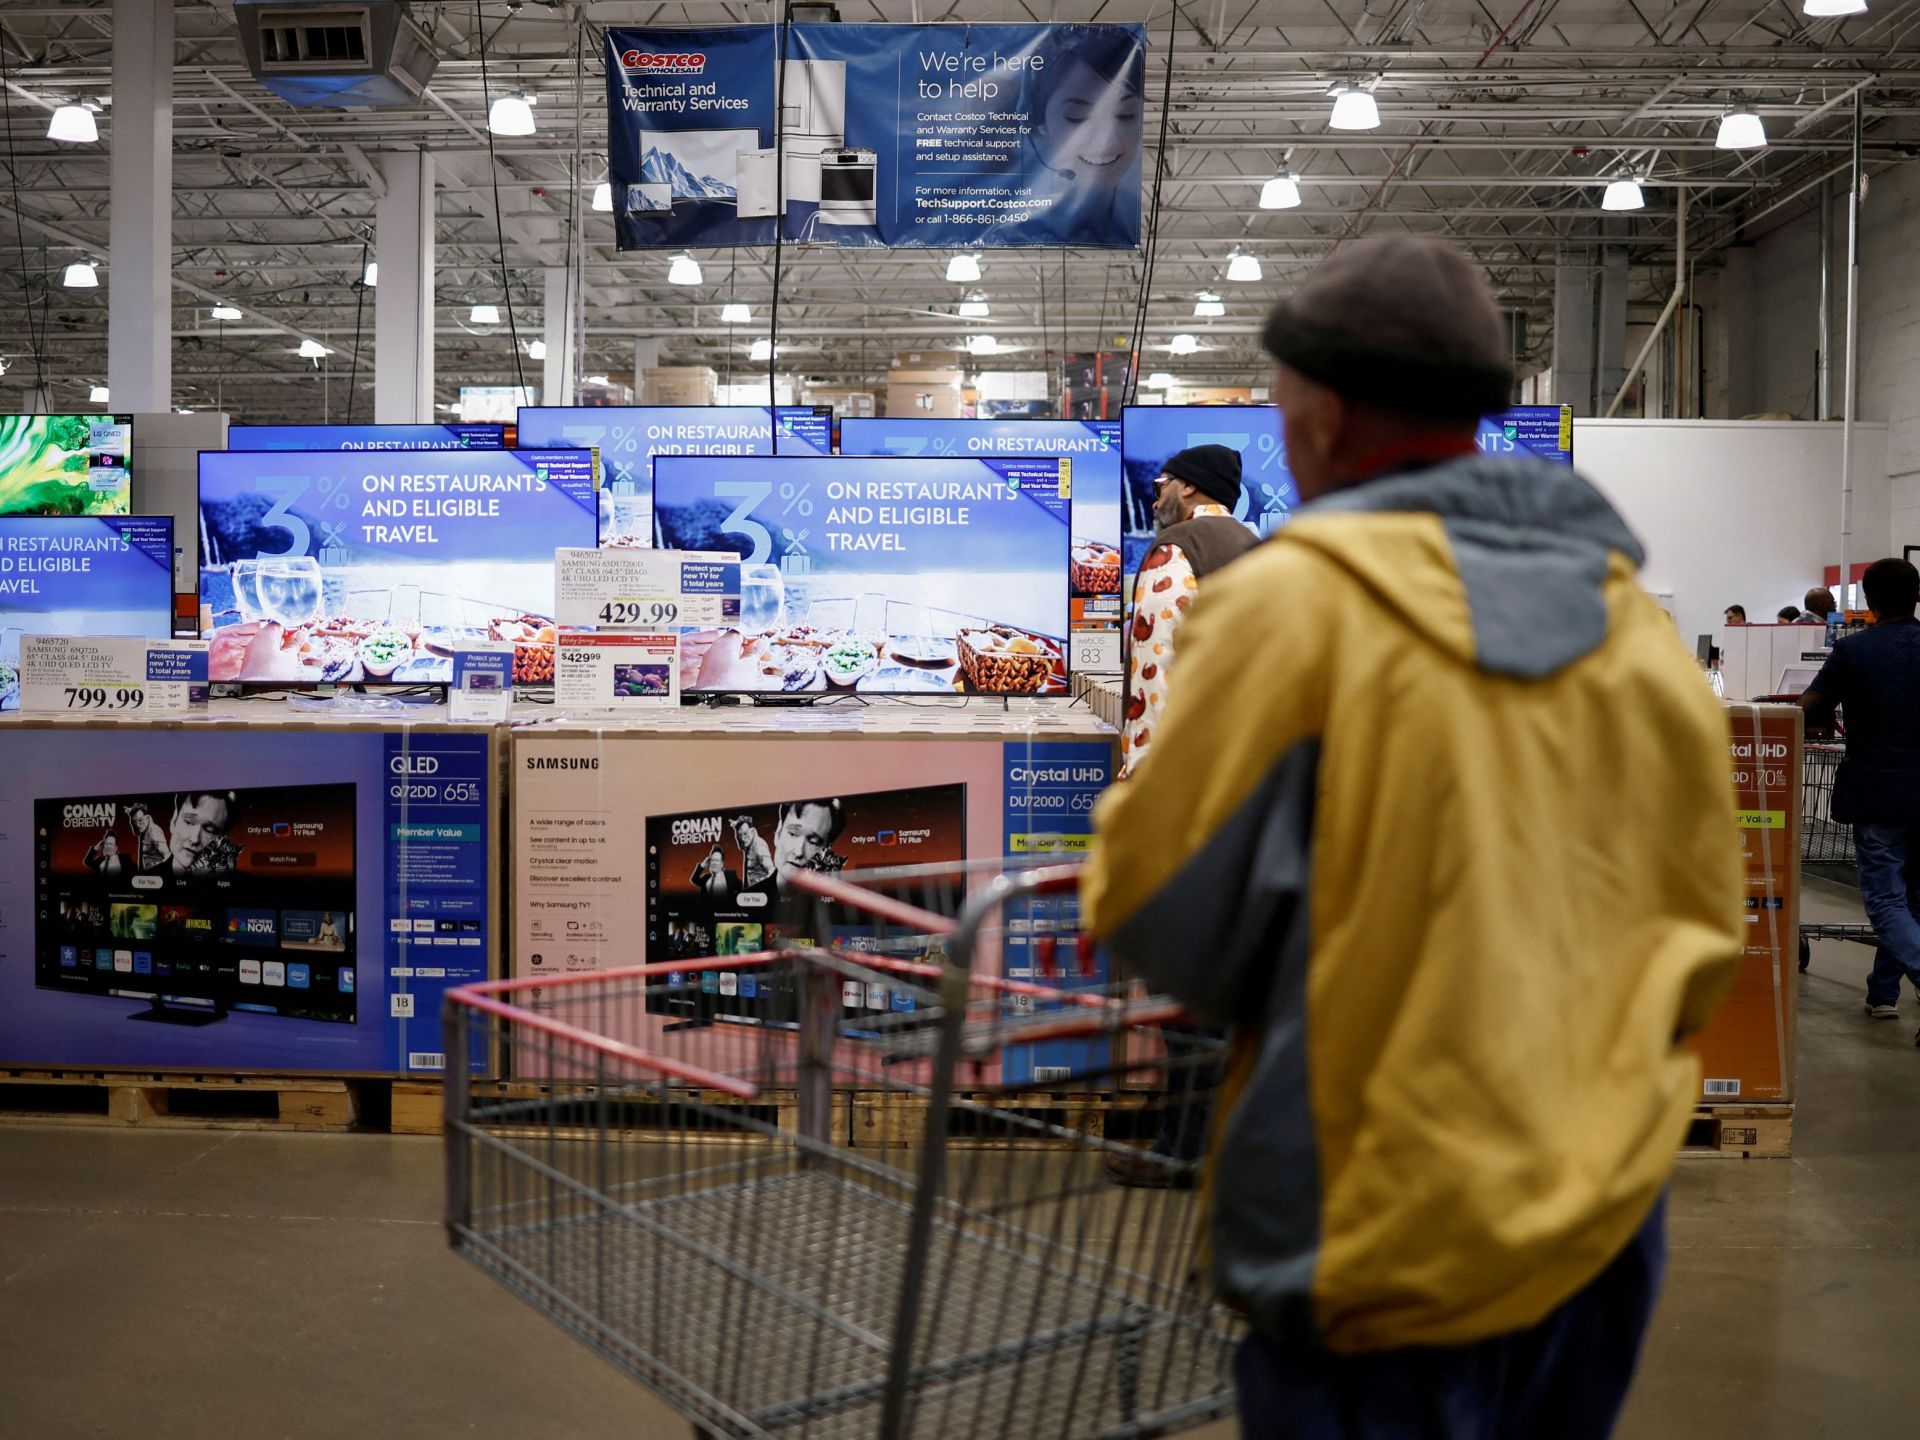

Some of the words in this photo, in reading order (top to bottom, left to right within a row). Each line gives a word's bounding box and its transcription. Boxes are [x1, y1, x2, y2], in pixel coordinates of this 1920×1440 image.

[622, 50, 706, 67] COSTCO
[919, 51, 986, 72] We're
[993, 50, 1044, 72] here
[622, 83, 686, 98] Technical
[689, 82, 716, 96] and
[918, 79, 942, 99] to
[949, 78, 998, 102] help
[622, 98, 686, 113] Warranty
[690, 96, 749, 110] Services
[917, 112, 952, 121] Contact
[954, 112, 986, 121] Costco
[988, 112, 1029, 121] Technical
[916, 126, 934, 135] and
[936, 126, 978, 136] Warranty
[979, 125, 1017, 134] Services
[1018, 125, 1032, 134] for
[916, 139, 942, 147] FREE
[944, 138, 983, 148] technical
[985, 140, 1021, 149] support
[916, 152, 934, 161] and
[935, 153, 960, 163] setup
[962, 152, 1009, 161] assistance.
[915, 186, 931, 195] For
[933, 187, 957, 195] more
[958, 186, 1012, 197] information,
[1014, 187, 1032, 196] visit
[915, 198, 1052, 209] TechSupport.Costco.com
[915, 216, 925, 224] or
[926, 215, 942, 224] call
[944, 212, 1029, 224] 1-866-861-0450
[646, 425, 673, 440] ON
[967, 437, 994, 451] ON
[996, 436, 1109, 452] RESTAURANTS
[362, 474, 395, 492] ON
[400, 474, 547, 492] RESTAURANTS
[826, 481, 862, 500] ON
[866, 481, 1018, 501] RESTAURANTS
[361, 499, 407, 517] AND
[412, 499, 500, 517] ELIGIBLE
[826, 507, 873, 525] AND
[879, 507, 969, 525] ELIGIBLE
[362, 525, 438, 543] TRAVEL
[8, 537, 130, 552] RESTAURANTS
[826, 533, 906, 551] TRAVEL
[570, 551, 603, 559] 9465072
[18, 557, 91, 572] ELIGIBLE
[561, 560, 601, 568] SAMSUNG
[602, 560, 643, 568] 65DU7200D
[0, 579, 41, 594] AVEL
[599, 602, 678, 624] 429.99
[1077, 636, 1105, 645] webOS
[58, 661, 80, 669] QLED
[64, 687, 144, 709] 799.99
[1755, 743, 1787, 758] UHD
[390, 756, 439, 774] QLED
[527, 757, 599, 770] SAMSUNG
[1010, 767, 1069, 786] Crystal
[1072, 767, 1104, 782] UHD
[390, 785, 437, 798] Q72DD
[1009, 795, 1065, 808] DU7200D
[63, 803, 116, 818] CONAN
[63, 817, 99, 828] O'BRIEN
[99, 816, 116, 827] TV
[293, 822, 324, 831] Samsung
[554, 819, 575, 827] range
[671, 816, 722, 835] CONAN
[1746, 815, 1772, 823] Value
[397, 828, 435, 837] Member
[437, 828, 462, 837] Value
[671, 833, 708, 845] O'BRIEN
[707, 831, 722, 843] TV
[852, 836, 866, 844] Only
[898, 829, 931, 837] Samsung
[529, 857, 554, 865] Crystal
[530, 901, 545, 909] Why
[546, 901, 578, 910] Samsung
[396, 997, 409, 1008] 18
